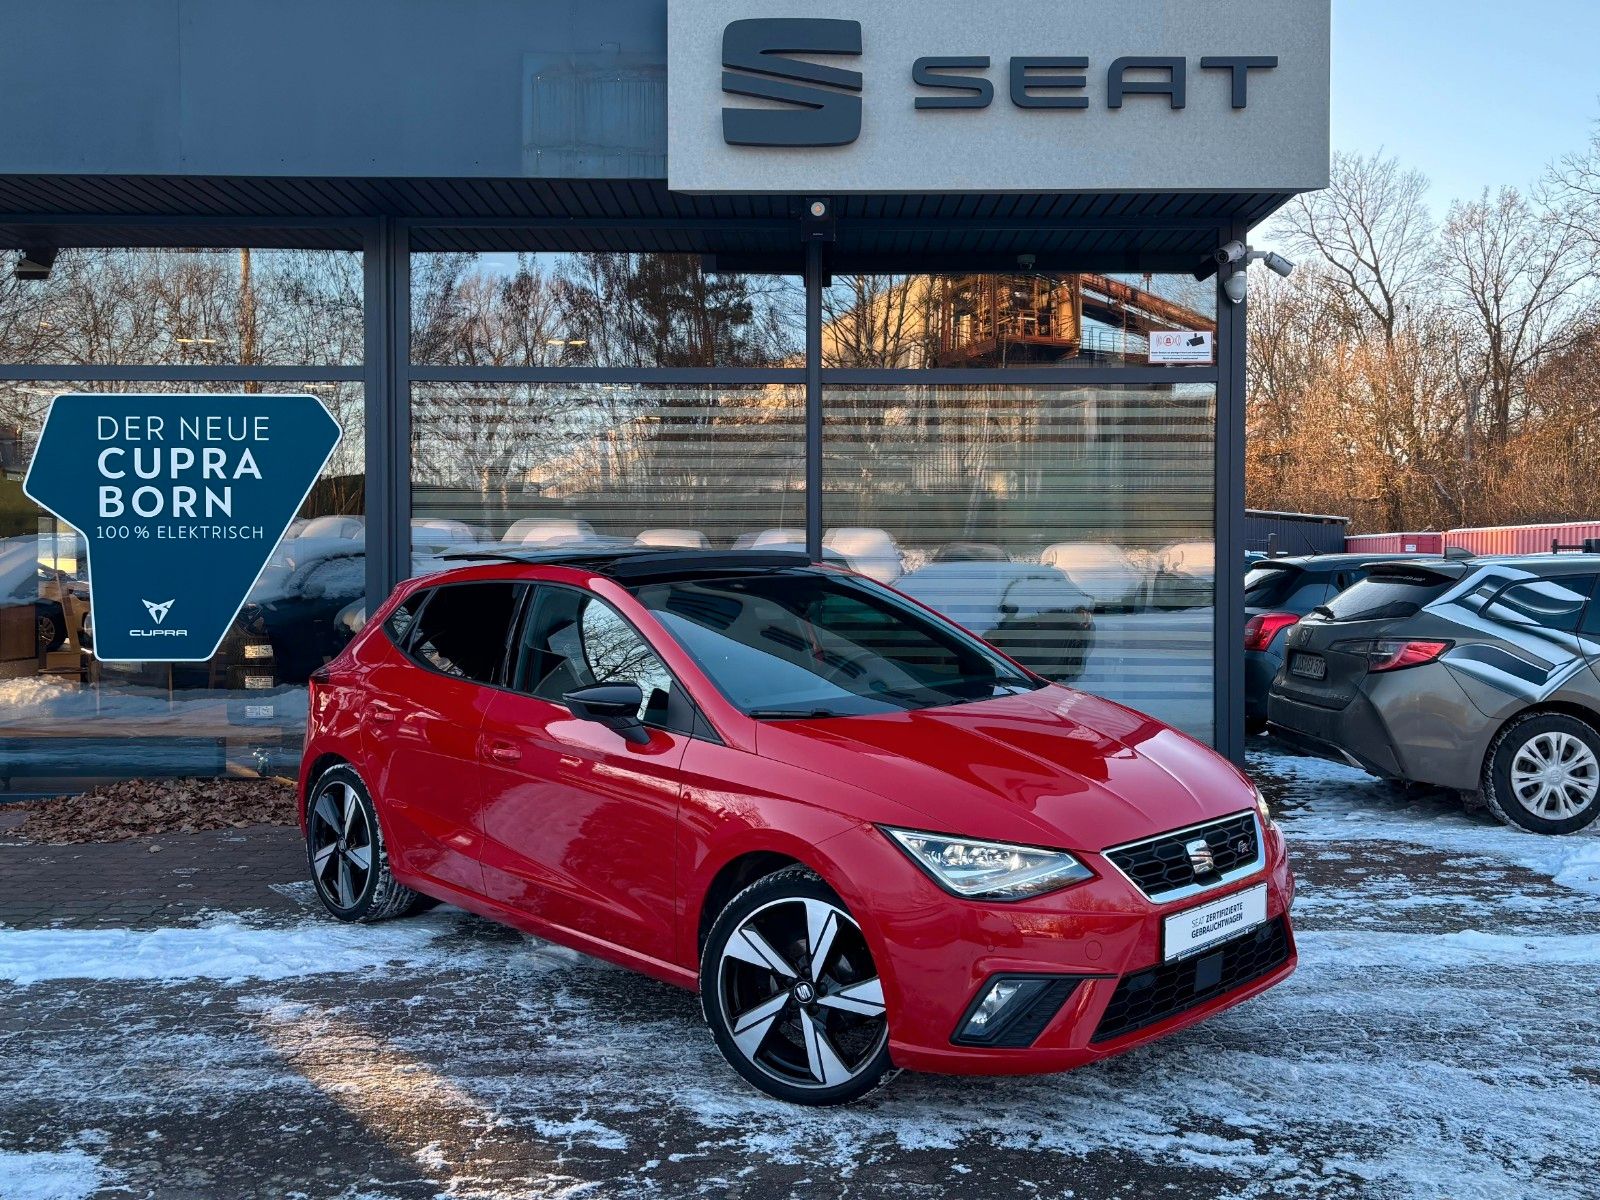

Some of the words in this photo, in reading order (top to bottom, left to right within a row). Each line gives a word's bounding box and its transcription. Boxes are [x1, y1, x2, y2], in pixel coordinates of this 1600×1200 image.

[911, 55, 1279, 110] SEAT
[97, 416, 164, 441] DER
[180, 416, 270, 441] NEUE
[97, 447, 263, 480] CUPRA
[99, 486, 232, 518] BORN
[96, 525, 130, 539] 100
[134, 525, 150, 539] %
[157, 525, 264, 539] ELEKTRISCH
[129, 629, 188, 637] CUPRA
[1191, 915, 1206, 928] SEAT
[1205, 902, 1243, 923] ZERTIFIZIERTE
[1191, 912, 1243, 939] GEBRAUCHTWAGEN
